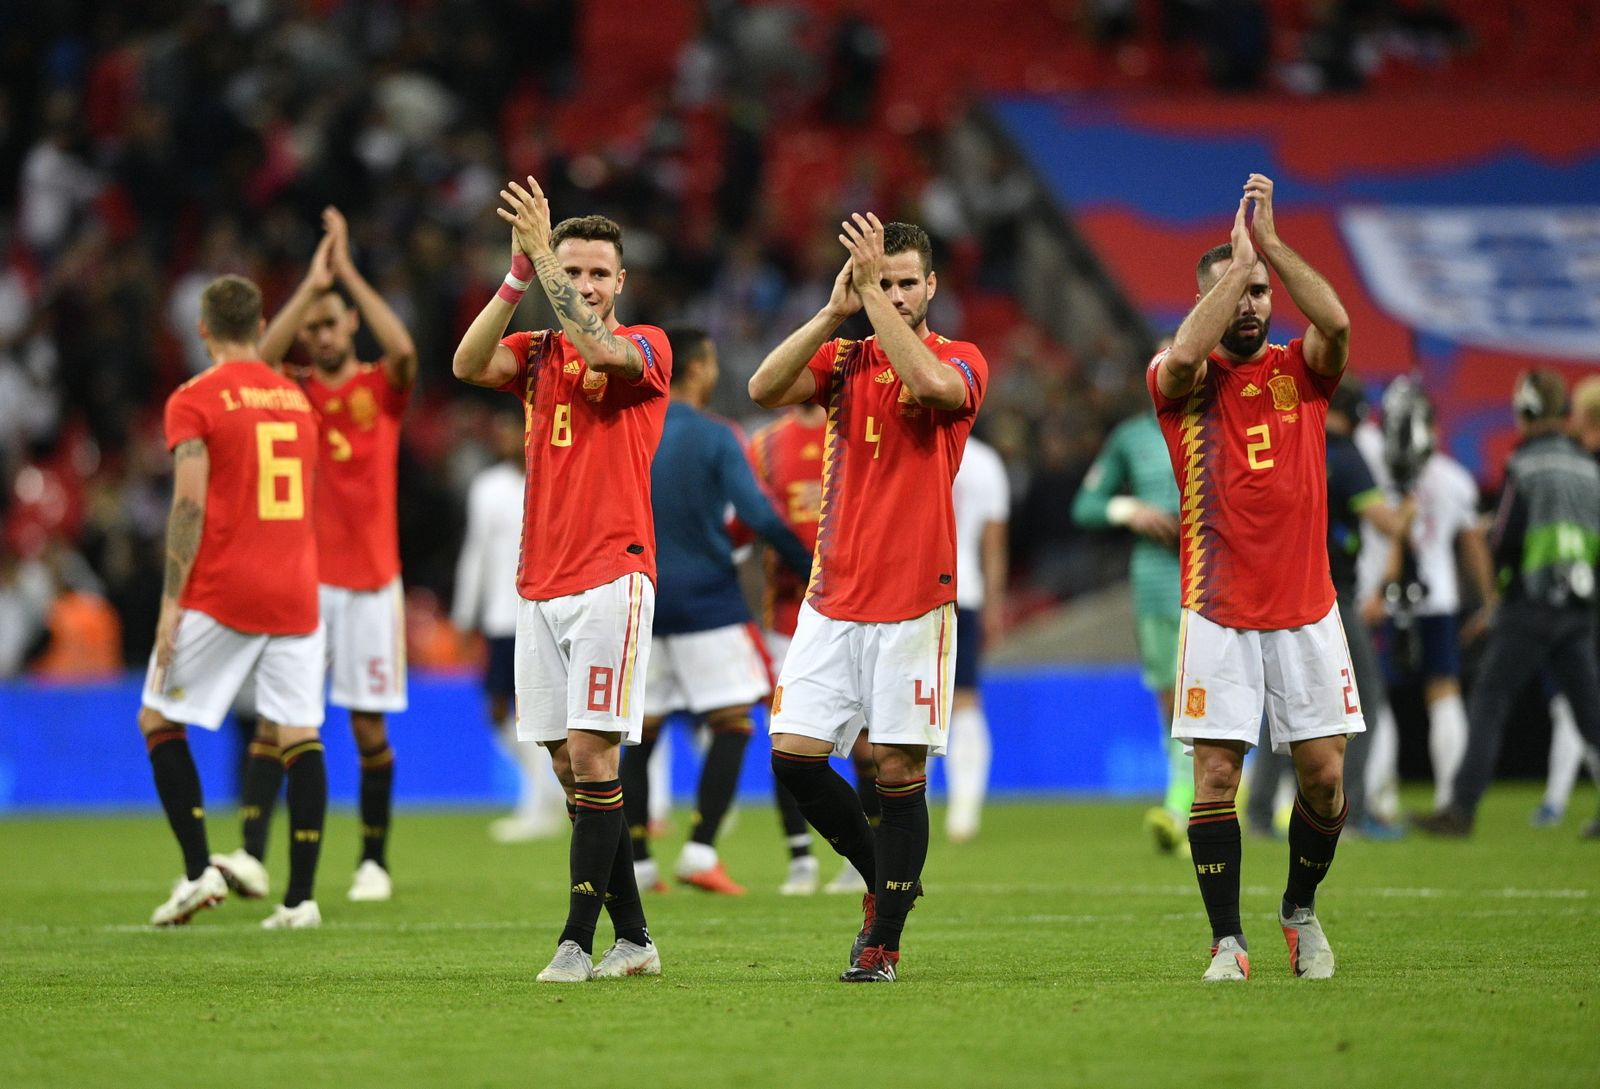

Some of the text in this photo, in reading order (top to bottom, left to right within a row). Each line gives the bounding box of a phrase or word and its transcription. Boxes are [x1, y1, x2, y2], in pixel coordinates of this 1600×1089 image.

[550, 402, 572, 452] 8
[865, 415, 883, 460] 4
[1246, 423, 1275, 471] 2
[256, 421, 304, 520] 6
[368, 656, 388, 695] 5
[587, 665, 614, 713] 8
[1340, 668, 1359, 715] 2
[914, 679, 936, 726] 4
